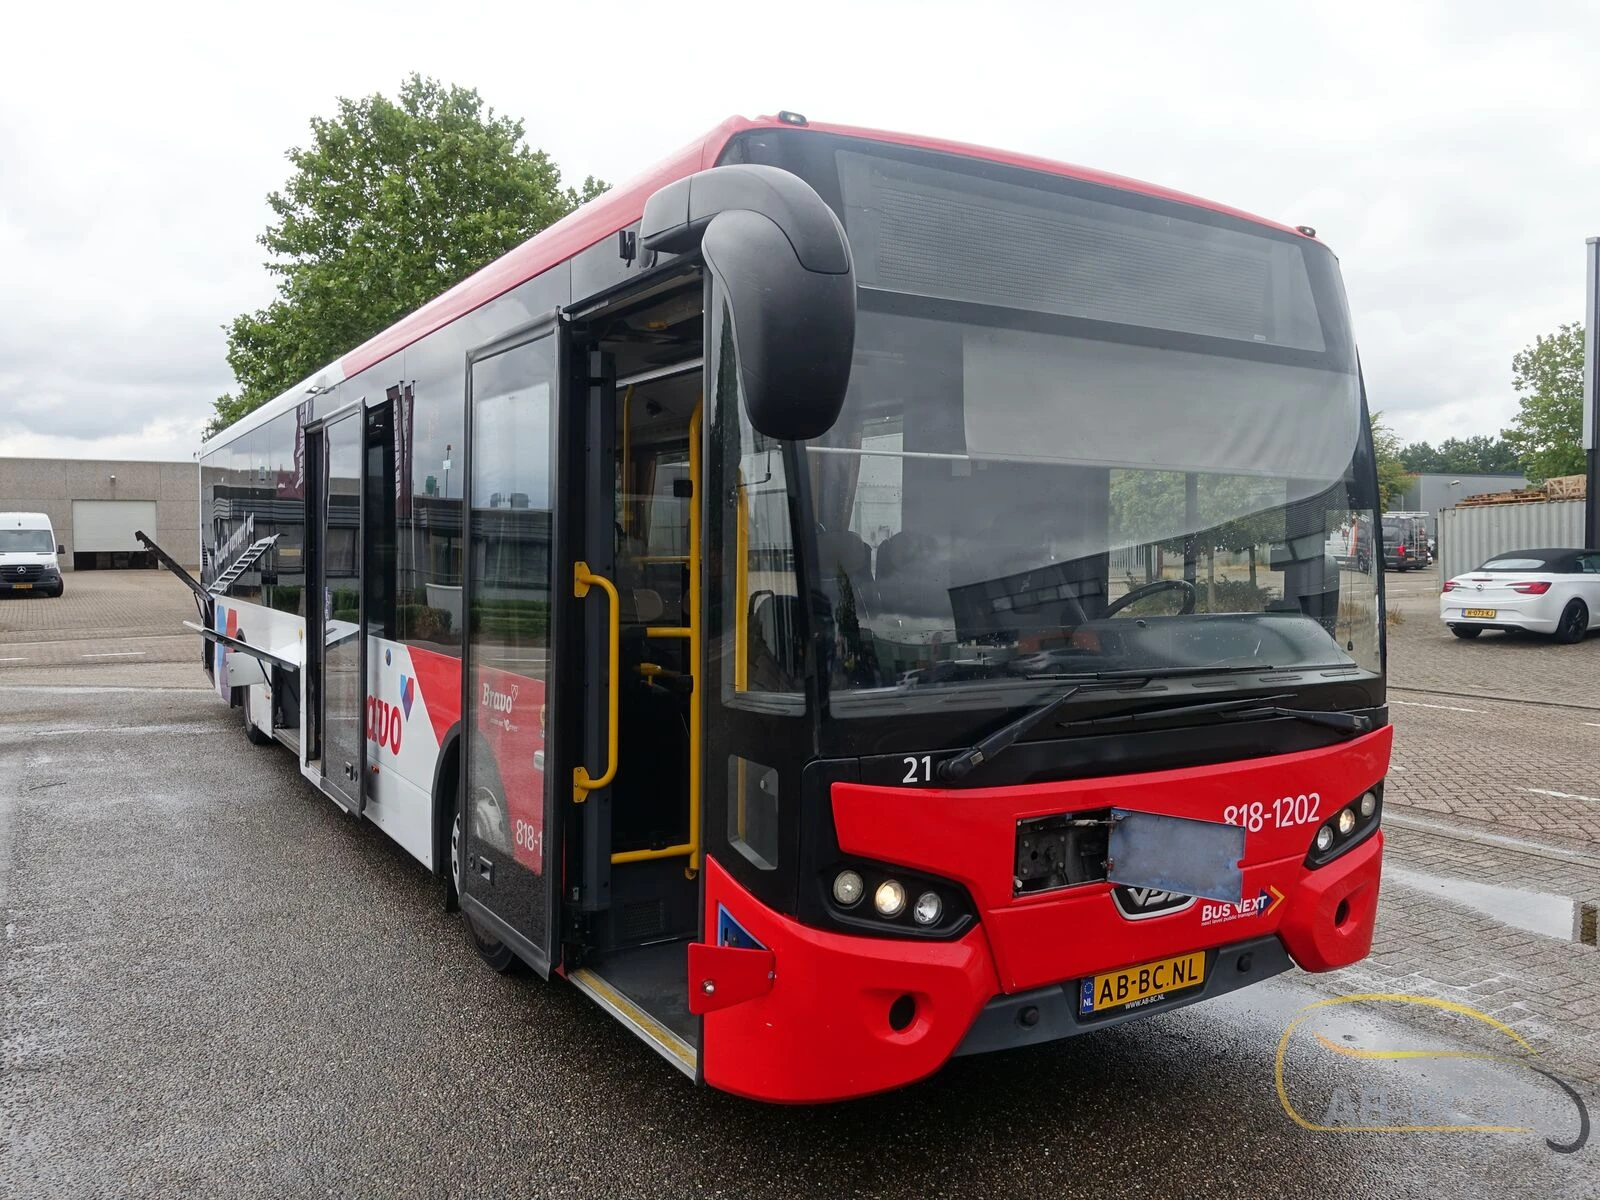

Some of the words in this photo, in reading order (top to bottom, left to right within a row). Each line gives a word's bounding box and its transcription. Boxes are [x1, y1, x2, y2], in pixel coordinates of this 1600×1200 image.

[482, 682, 513, 714] Bravo
[902, 755, 931, 783] 21
[1223, 792, 1321, 833] 818-1202
[1201, 903, 1231, 922] BUS
[1083, 998, 1093, 1008] NL
[1098, 958, 1198, 1005] AB-BC.NL
